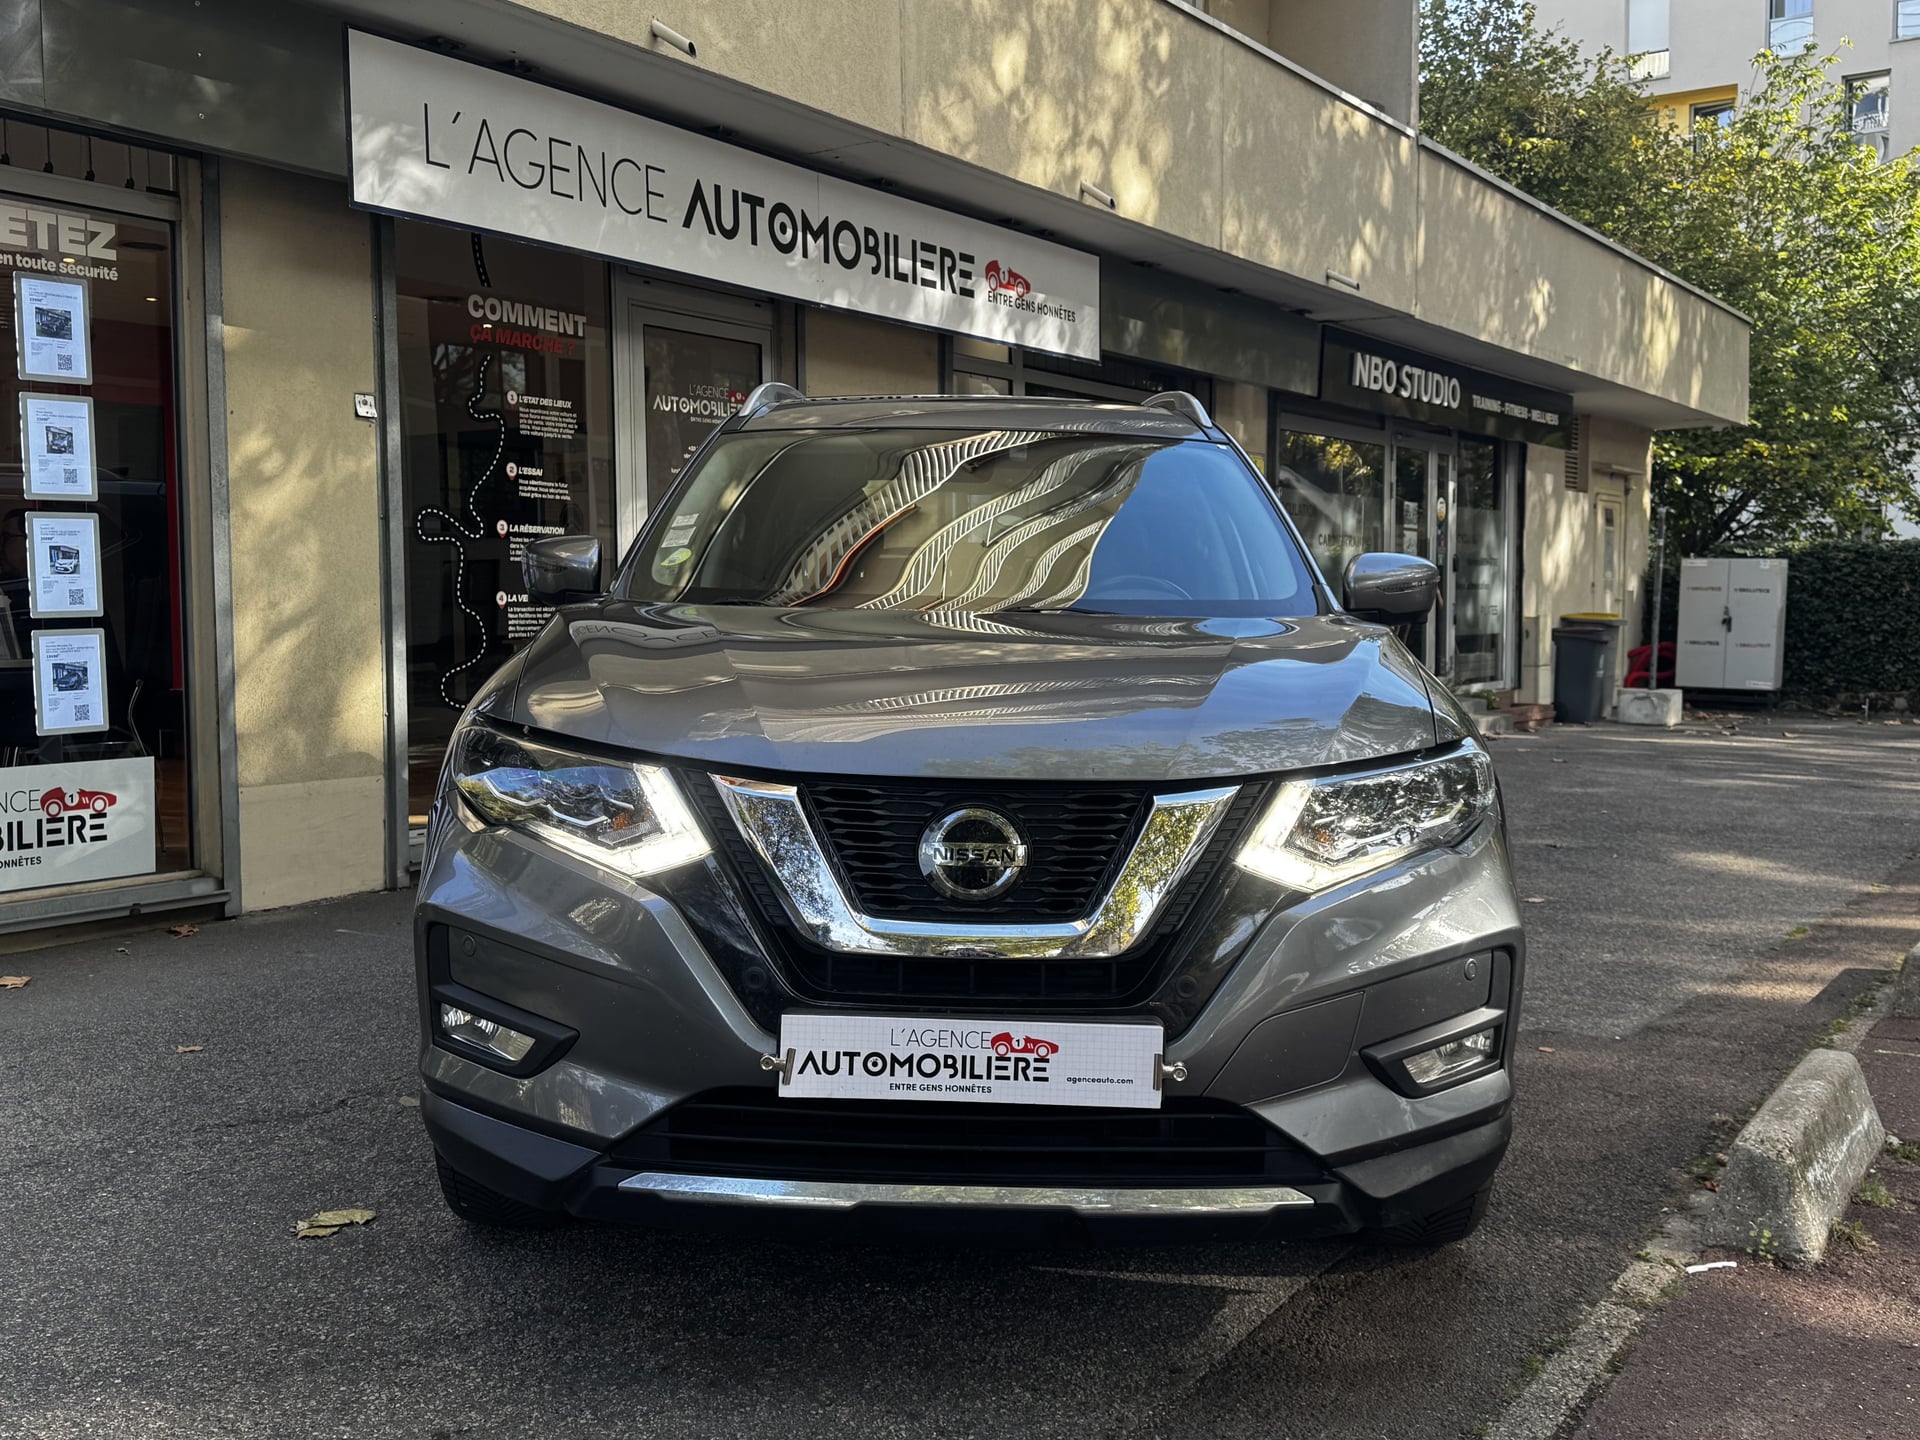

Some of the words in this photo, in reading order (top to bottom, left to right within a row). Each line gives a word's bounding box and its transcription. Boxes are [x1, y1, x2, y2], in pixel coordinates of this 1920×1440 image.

[682, 179, 975, 298] AUTOMOBILIERE
[15, 253, 56, 271] toute
[468, 294, 587, 337] COMMENT
[988, 291, 1013, 307] ENTRE
[1015, 297, 1035, 313] GENS
[1037, 303, 1076, 322] HONNÊTES
[495, 328, 563, 354] MARCHE
[1352, 352, 1397, 394] NBO
[1400, 364, 1461, 409] STUDIO
[540, 397, 553, 406] DES
[553, 399, 572, 408] LIEUX
[519, 466, 543, 476] L'ESSAI
[509, 524, 518, 532] LA
[520, 523, 565, 535] RÉSERVATION
[508, 594, 517, 602] LA
[933, 847, 1016, 862] NISSAN
[890, 1028, 991, 1049] L'AGENCE
[797, 1050, 1050, 1082] AUTOMOBILIERE
[889, 1083, 917, 1091] ENTRE
[919, 1084, 943, 1092] GENS
[945, 1083, 992, 1093] HONNÊTES
[1066, 1075, 1134, 1085] agenceauto.com
